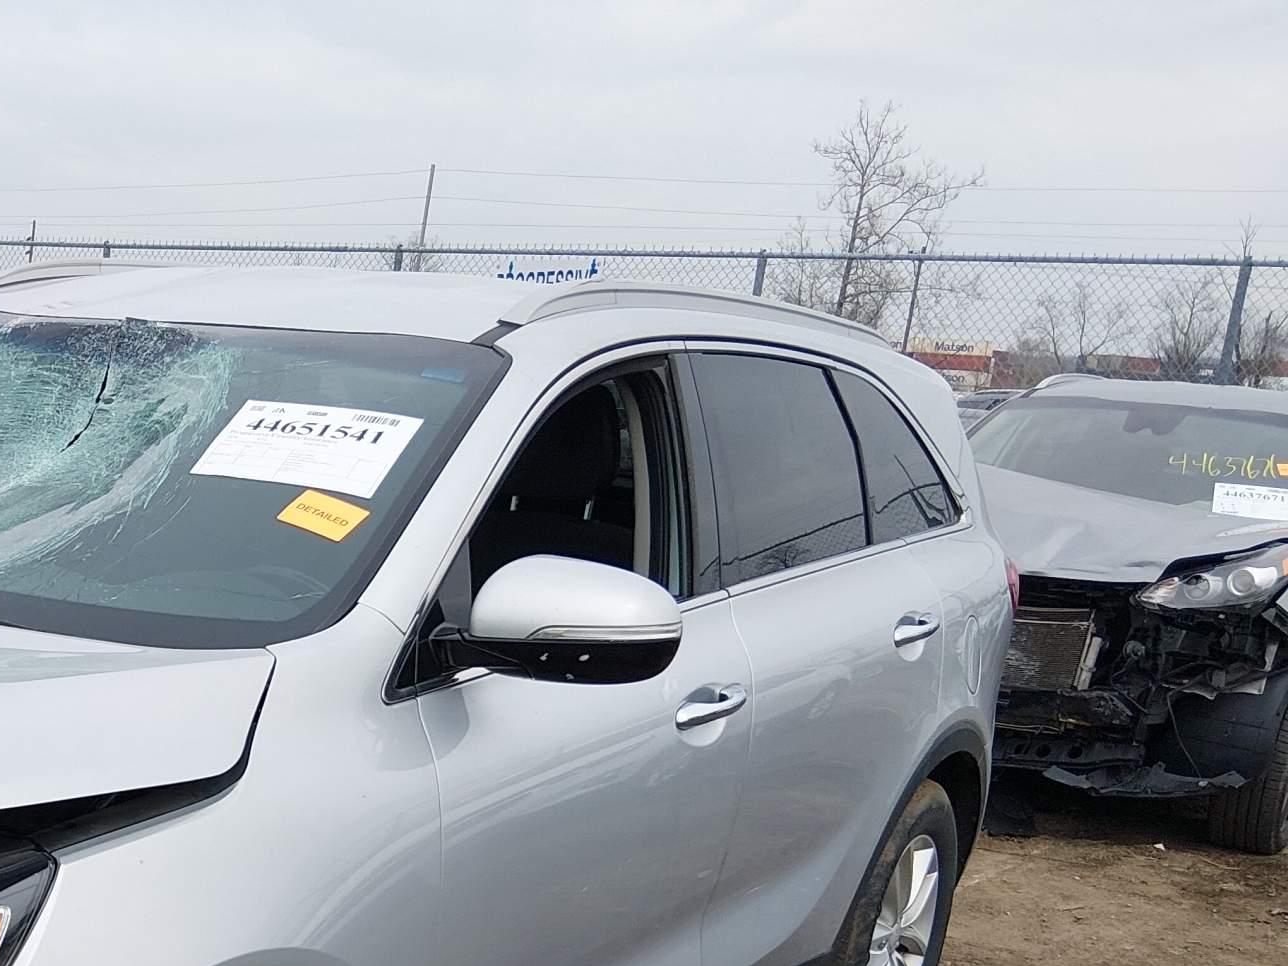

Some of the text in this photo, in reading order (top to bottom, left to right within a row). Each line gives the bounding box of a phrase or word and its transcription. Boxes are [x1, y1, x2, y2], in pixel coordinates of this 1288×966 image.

[935, 341, 975, 352] Matson
[246, 417, 385, 445] 44651541
[1222, 490, 1285, 502] 44637671
[295, 502, 350, 527] DETAILED
